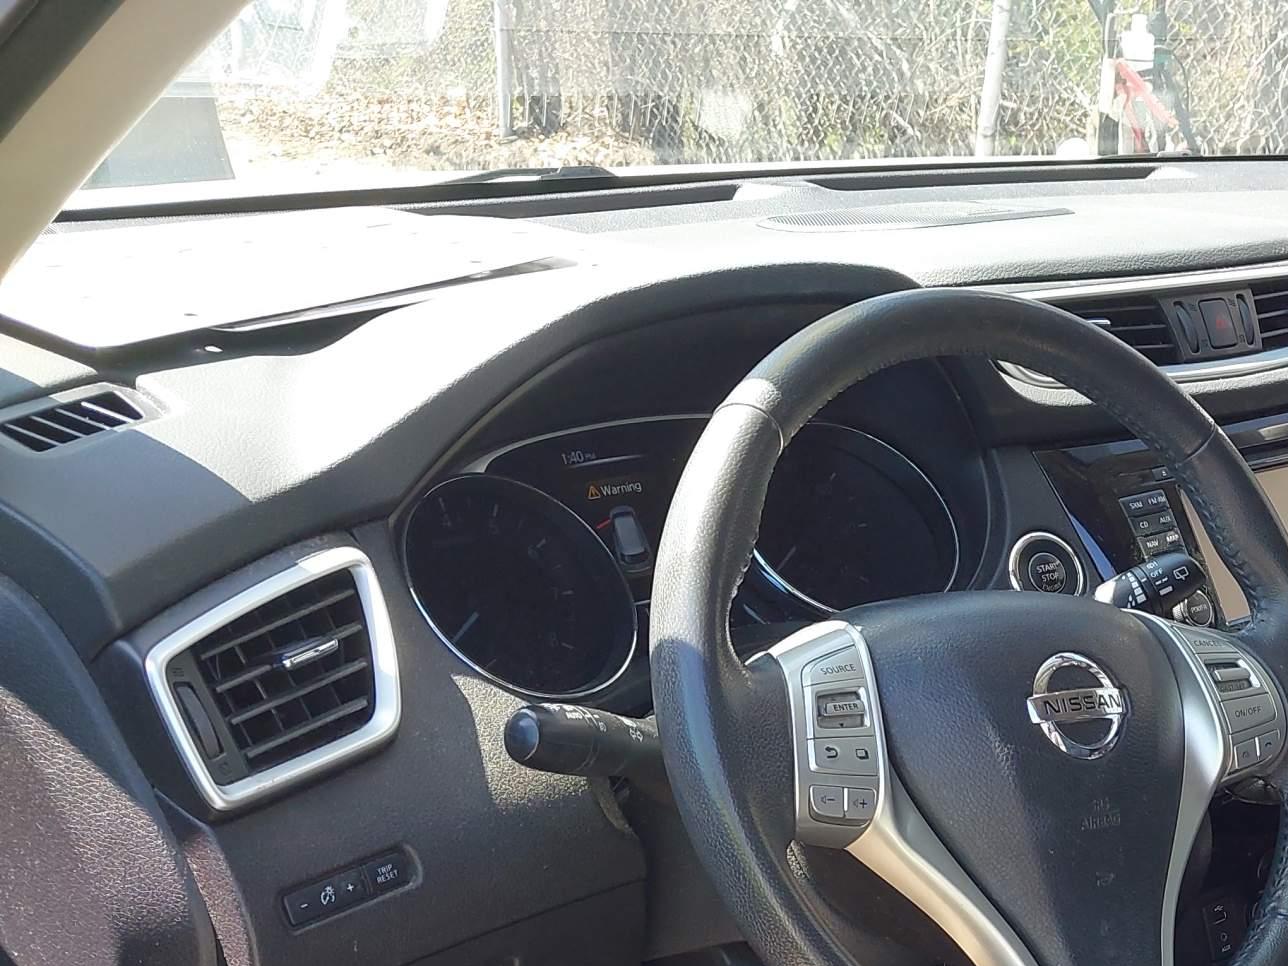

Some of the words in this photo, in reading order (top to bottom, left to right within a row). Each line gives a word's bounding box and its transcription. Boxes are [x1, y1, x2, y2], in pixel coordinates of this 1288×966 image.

[561, 450, 583, 465] 1:40
[601, 480, 642, 497] Warning
[1139, 521, 1149, 529] CD
[1159, 514, 1171, 524] AUX
[1146, 539, 1159, 549] NAV
[1036, 561, 1058, 574] START
[1150, 568, 1163, 579] OFF
[821, 663, 857, 675] SOURCE
[833, 702, 859, 712] ENTER
[1044, 693, 1122, 714] NISSAN
[1234, 706, 1262, 718] ON/OFF
[377, 863, 393, 875] TRIP
[376, 869, 399, 884] RESET
